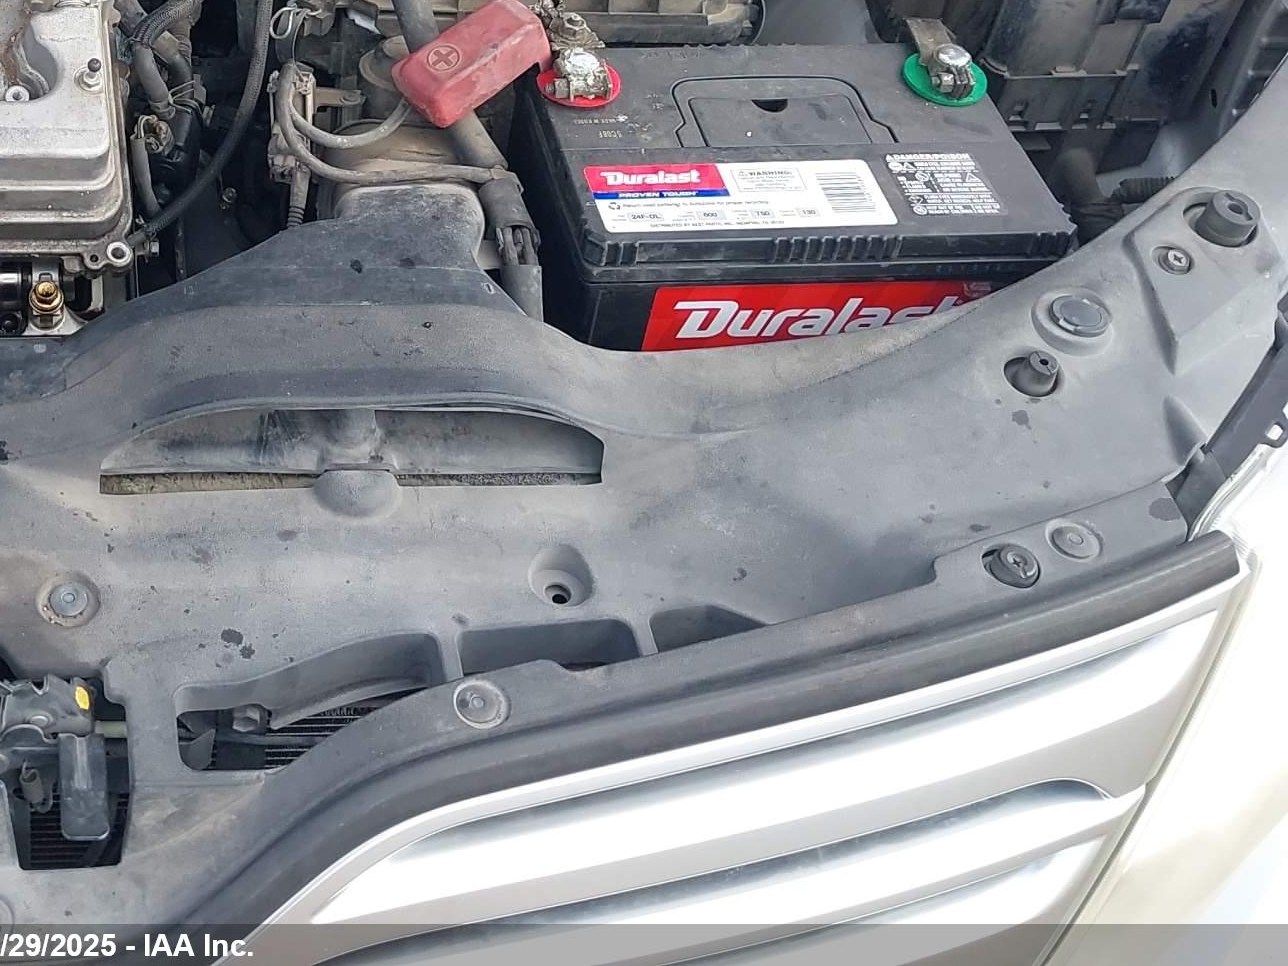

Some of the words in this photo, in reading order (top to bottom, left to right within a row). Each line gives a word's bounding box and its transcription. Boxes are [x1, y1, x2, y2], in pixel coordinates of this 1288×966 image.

[600, 168, 701, 186] Duralast
[618, 191, 660, 199] PROVEN
[663, 190, 696, 198] TOUGH
